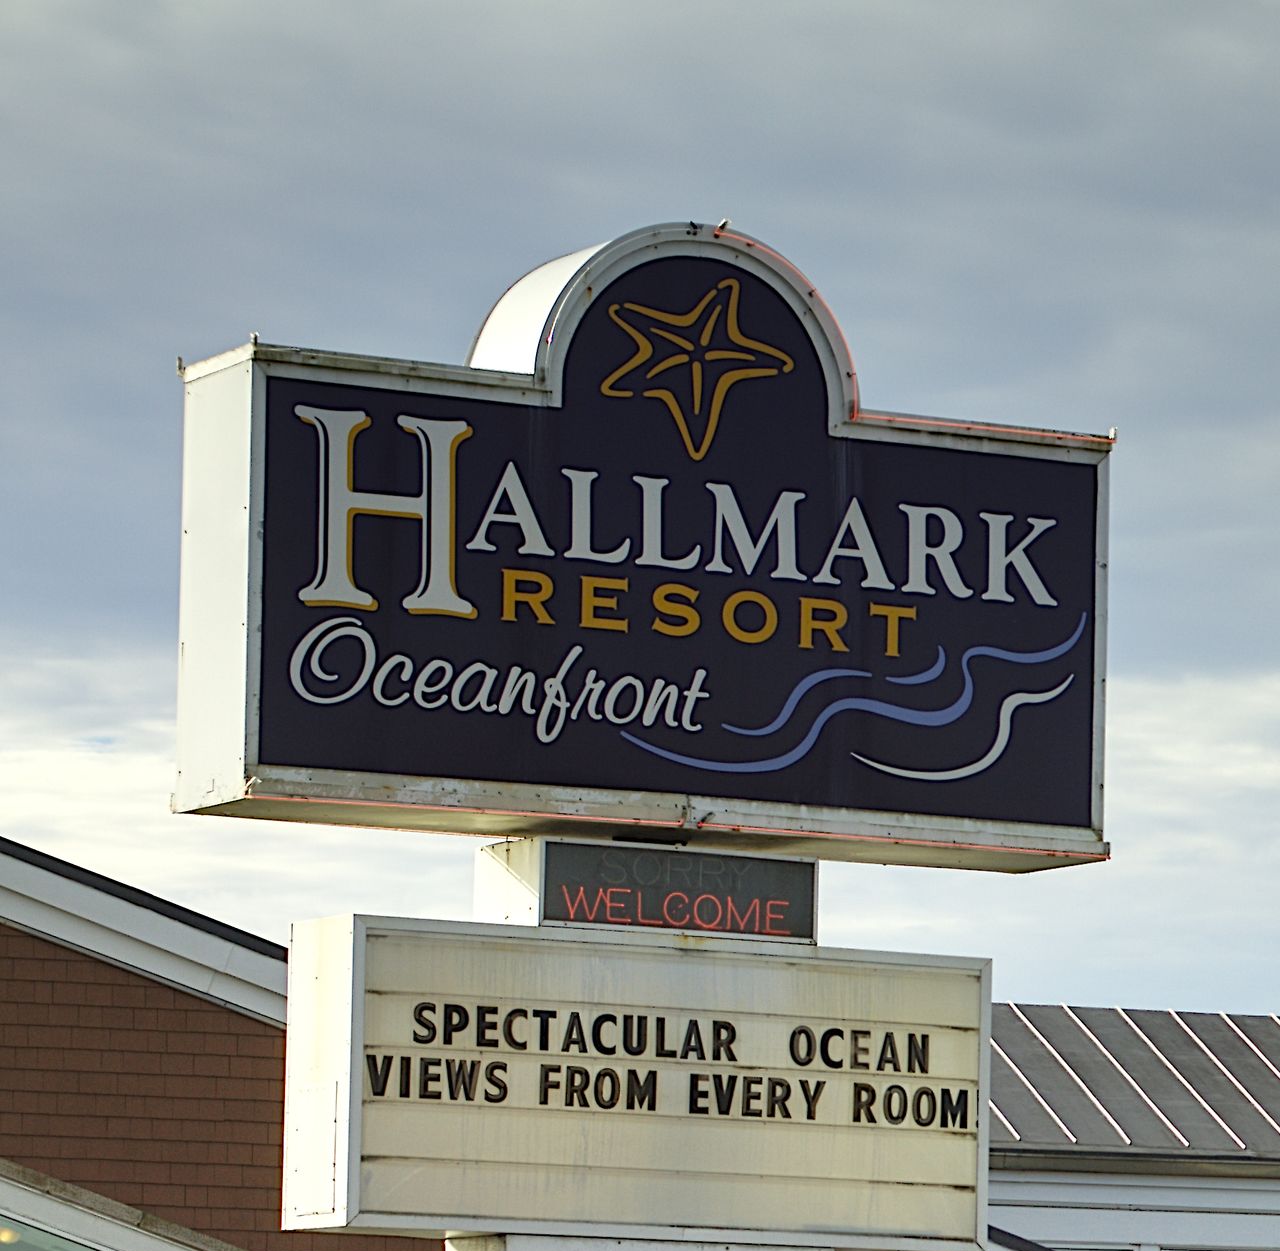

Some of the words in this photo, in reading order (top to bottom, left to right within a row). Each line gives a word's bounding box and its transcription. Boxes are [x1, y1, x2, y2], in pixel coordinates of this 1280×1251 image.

[294, 405, 1057, 619] HALLMARK
[501, 569, 917, 657] RESORT
[289, 616, 710, 744] Oceanfront
[562, 885, 792, 935] WELCOME
[413, 1001, 738, 1063] SPECTACULAR
[789, 1025, 931, 1074] OCEAN
[366, 1053, 509, 1103] VIEWS
[539, 1063, 658, 1113] FROM
[689, 1073, 827, 1121] EVERY
